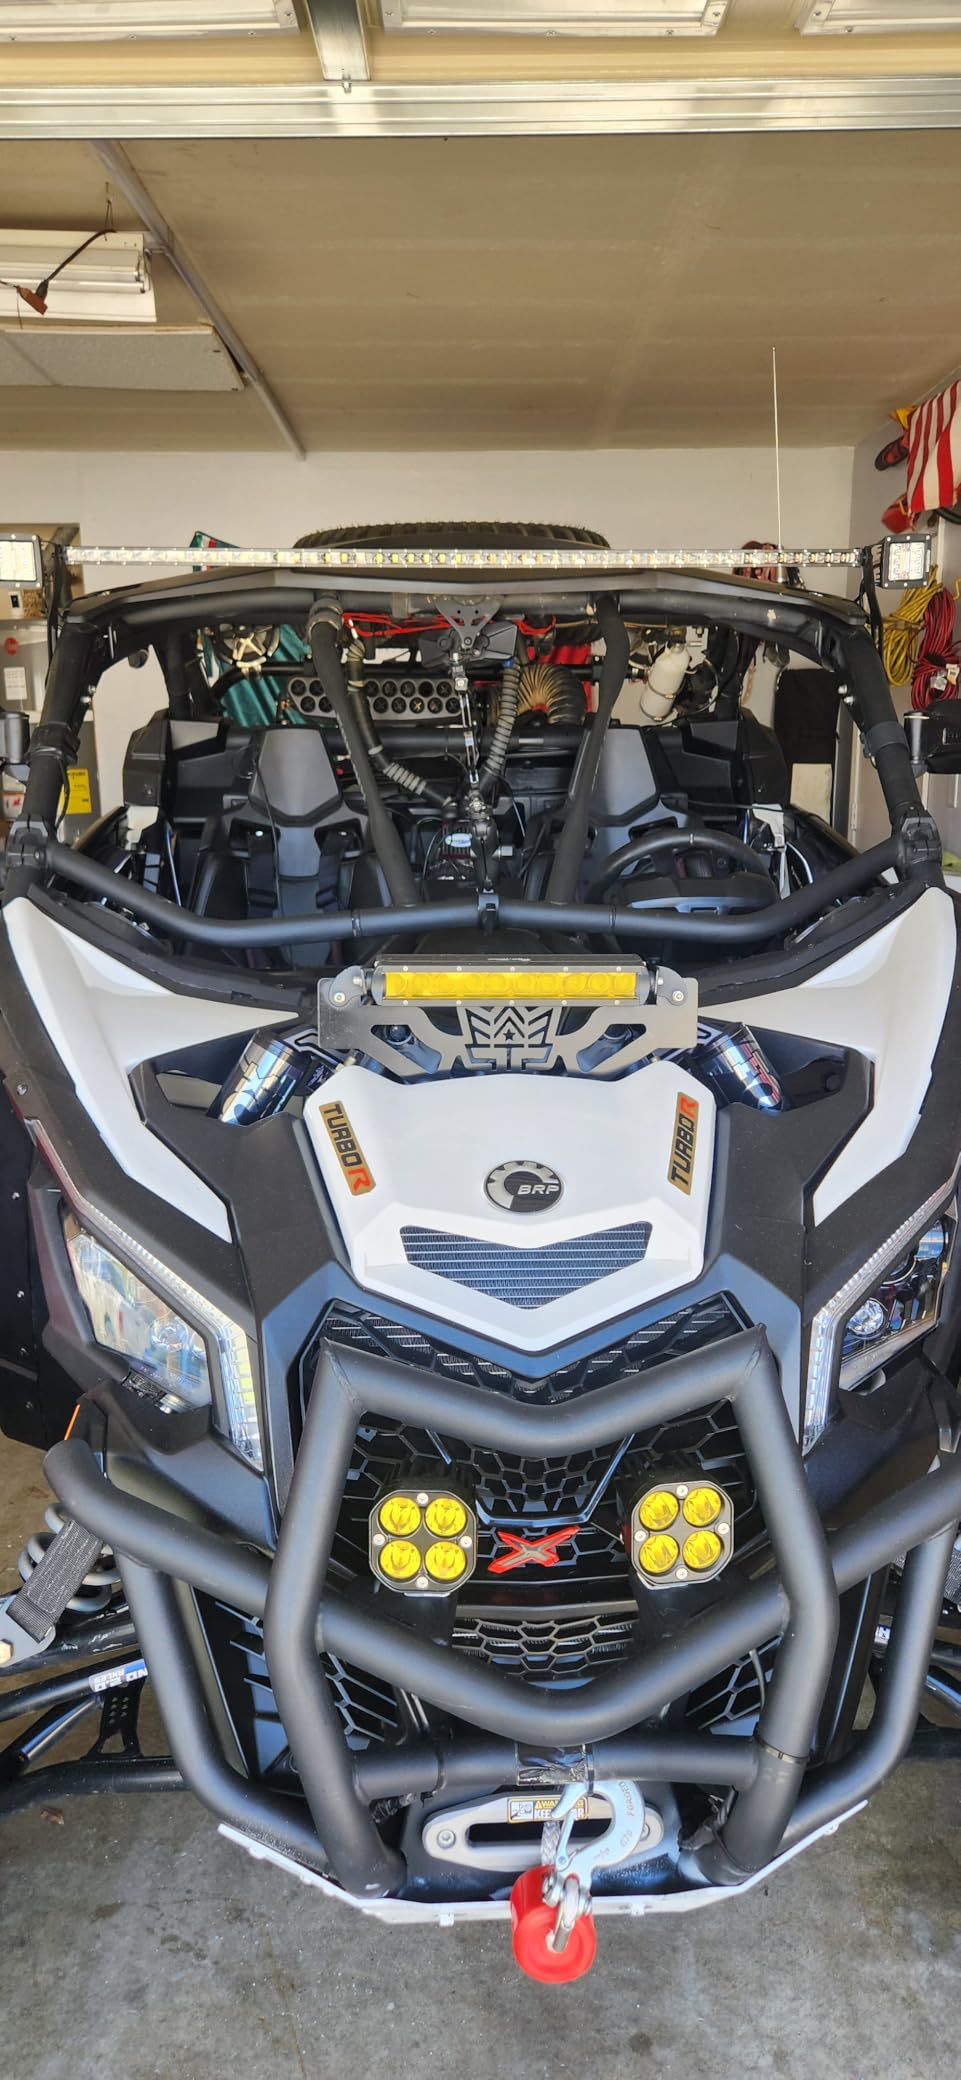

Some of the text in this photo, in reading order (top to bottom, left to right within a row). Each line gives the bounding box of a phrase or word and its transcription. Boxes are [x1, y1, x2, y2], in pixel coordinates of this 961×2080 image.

[324, 1103, 362, 1167] TURBO
[671, 1113, 694, 1186] TURBO
[517, 1184, 559, 1195] BRP
